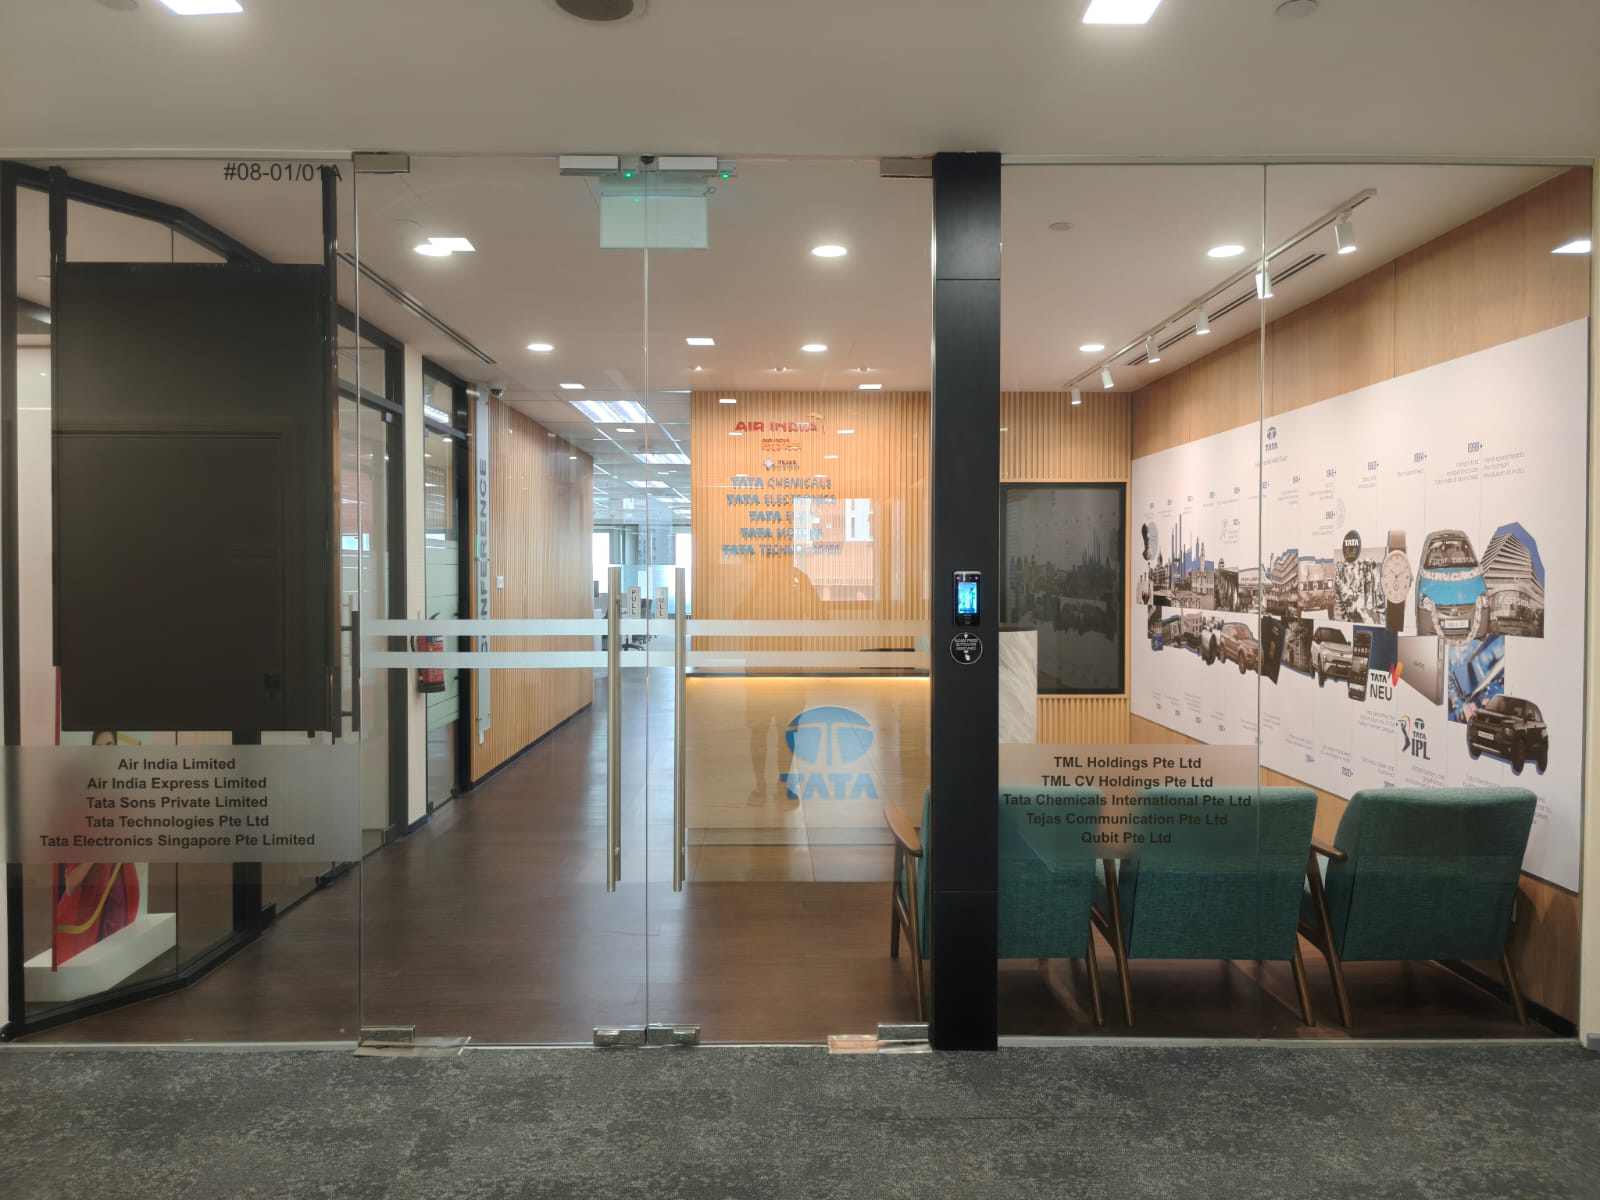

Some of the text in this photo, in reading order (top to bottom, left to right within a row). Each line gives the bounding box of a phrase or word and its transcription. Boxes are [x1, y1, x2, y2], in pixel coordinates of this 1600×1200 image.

[735, 421, 764, 432] AIR
[479, 458, 488, 653] CNFERENCE
[1370, 672, 1388, 684] TATA
[1369, 684, 1393, 701] NEU
[1411, 738, 1431, 761] IPL
[118, 758, 236, 770] Air India Limited
[1053, 756, 1202, 771] TML Holdings Pte Ltd
[87, 777, 267, 792] Air India Express Limited
[778, 772, 879, 801] TATA
[1041, 775, 1213, 789] TML CV Holdings Pte Ltd
[86, 796, 268, 809] Tata Sons Private Limited
[1003, 793, 1252, 807] Tata Chemicals International Pte Ltd
[84, 815, 269, 830] Tata Technologies Pte Ltd
[1026, 812, 1228, 827] Tejas Communication Pte Ltd
[40, 833, 315, 849] Tata Electronics Singapore Pte Limited
[1081, 832, 1171, 844] Qubit Pte Ltd
